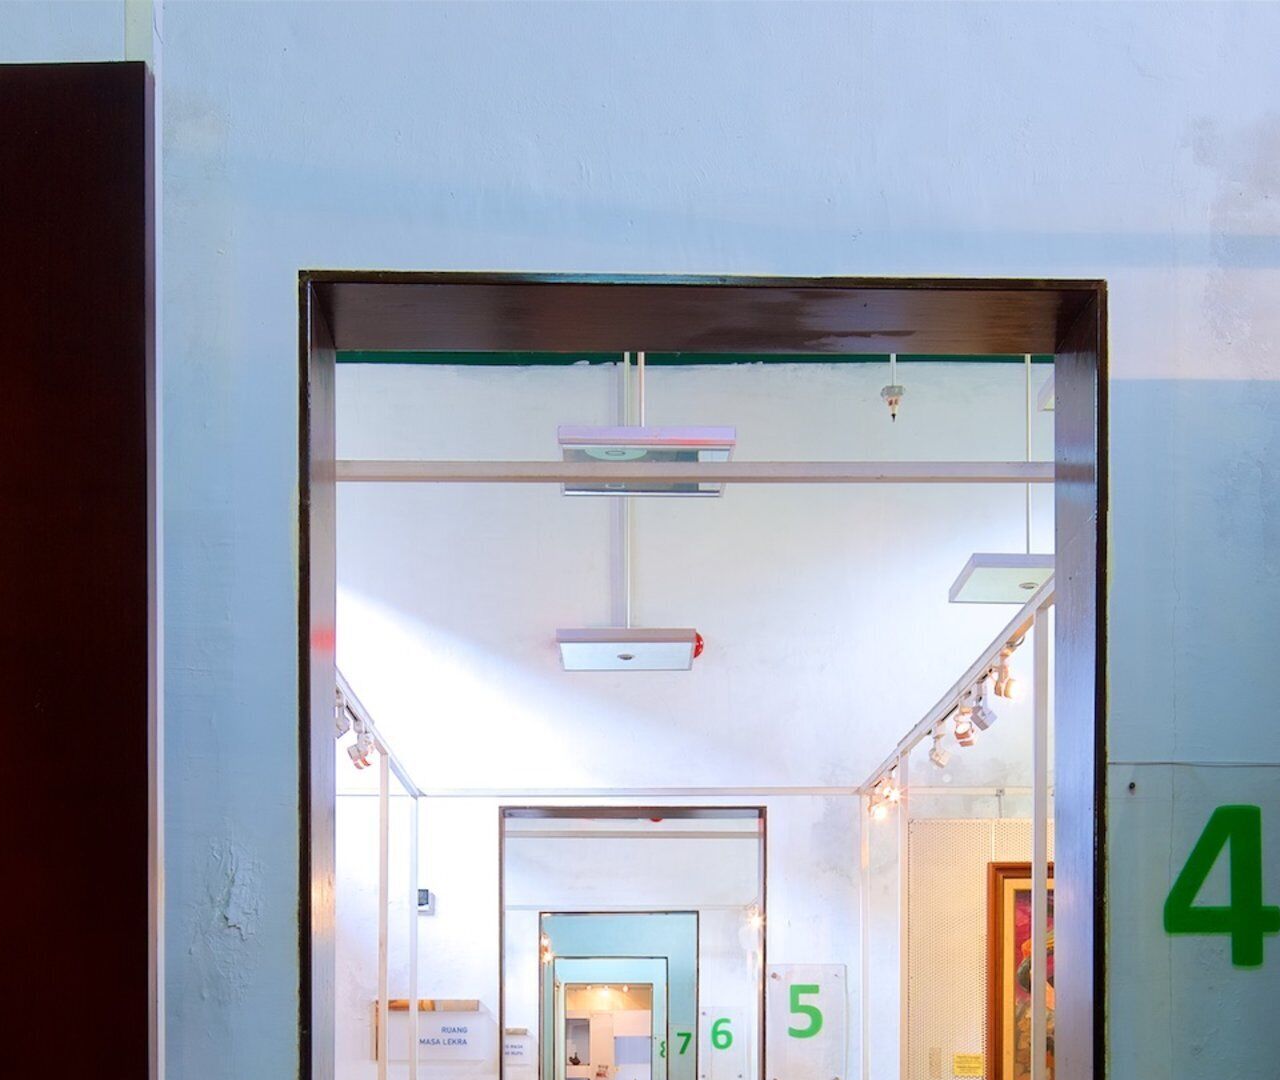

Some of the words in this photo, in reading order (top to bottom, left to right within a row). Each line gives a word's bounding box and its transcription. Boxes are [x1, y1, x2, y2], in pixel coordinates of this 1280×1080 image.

[788, 984, 823, 1039] 5
[441, 1026, 468, 1034] RUANG
[676, 1032, 692, 1055] 7
[710, 1018, 733, 1050] 6
